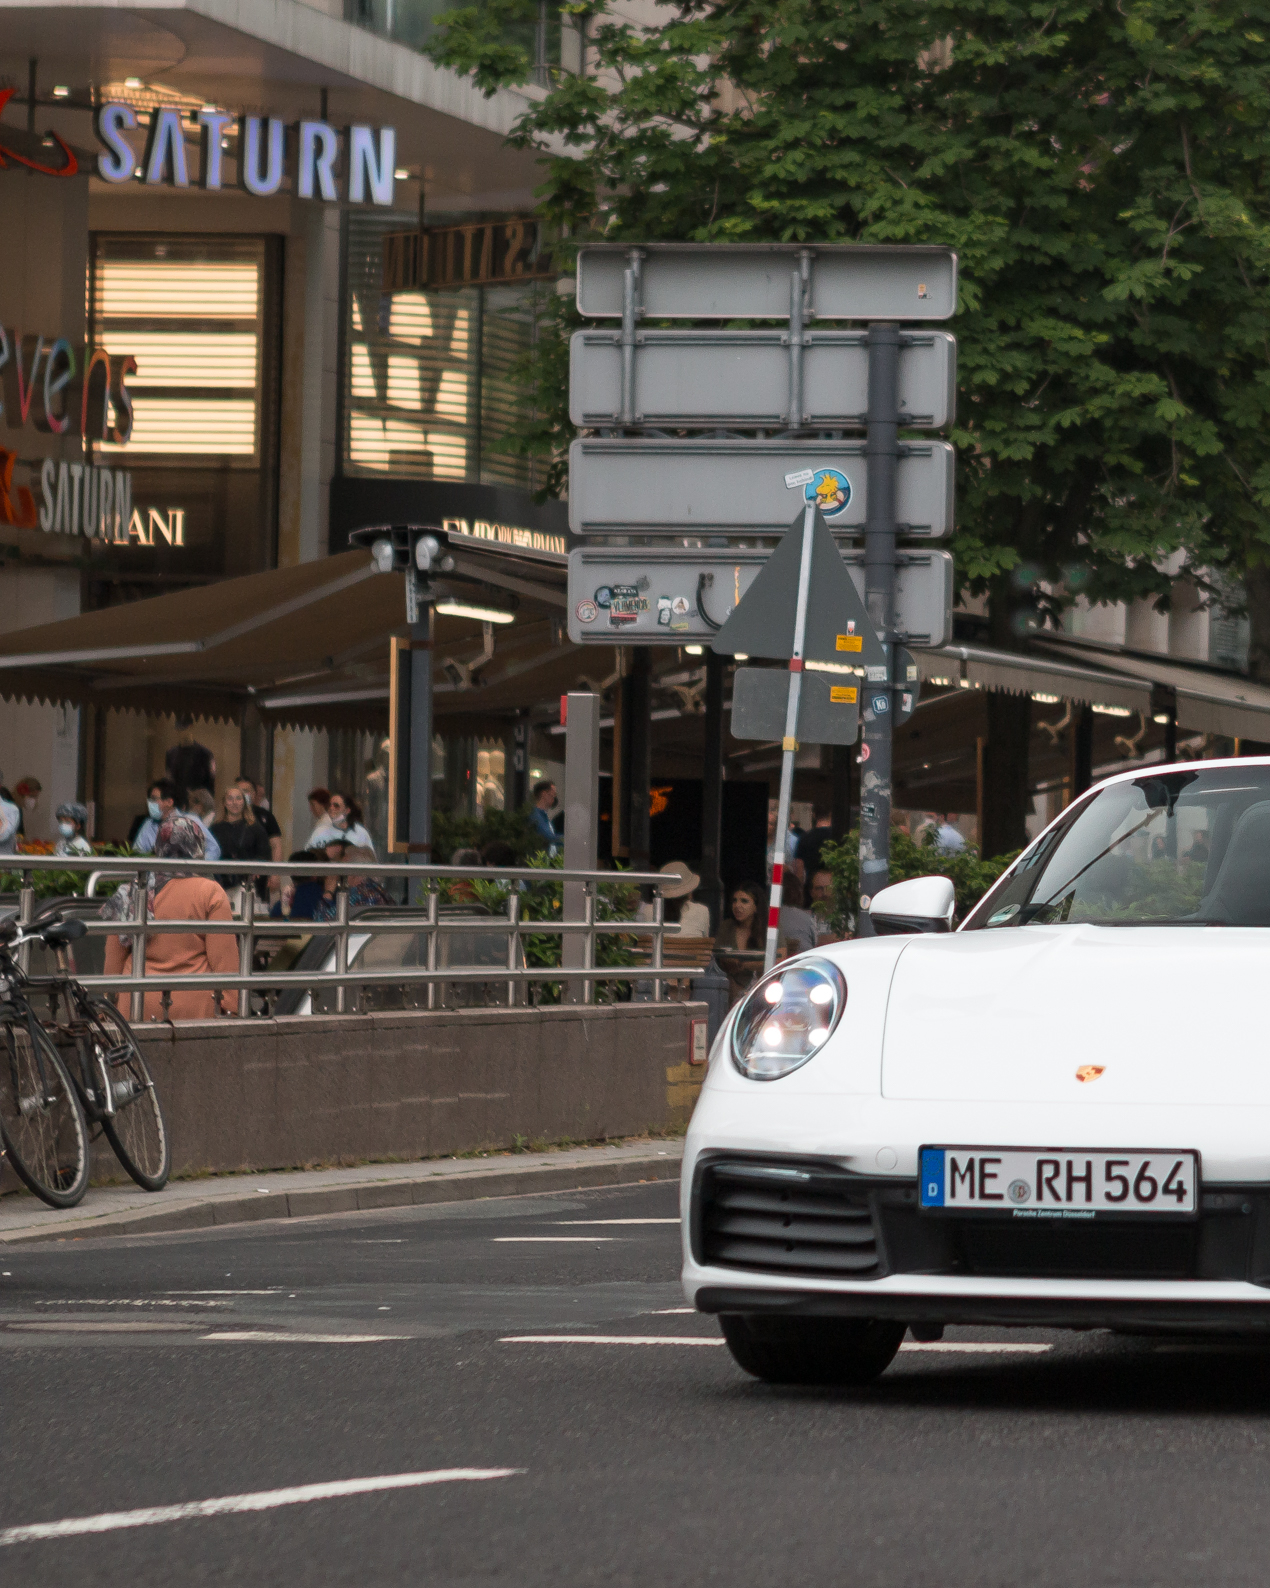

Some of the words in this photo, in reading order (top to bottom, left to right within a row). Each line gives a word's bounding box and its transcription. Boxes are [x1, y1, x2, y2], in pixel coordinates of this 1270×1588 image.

[98, 101, 396, 206] SATURN
[40, 457, 132, 540] SATURN
[928, 1183, 938, 1197] D
[950, 1157, 1004, 1200] ME
[1036, 1158, 1093, 1203] RH
[1104, 1160, 1188, 1203] 564
